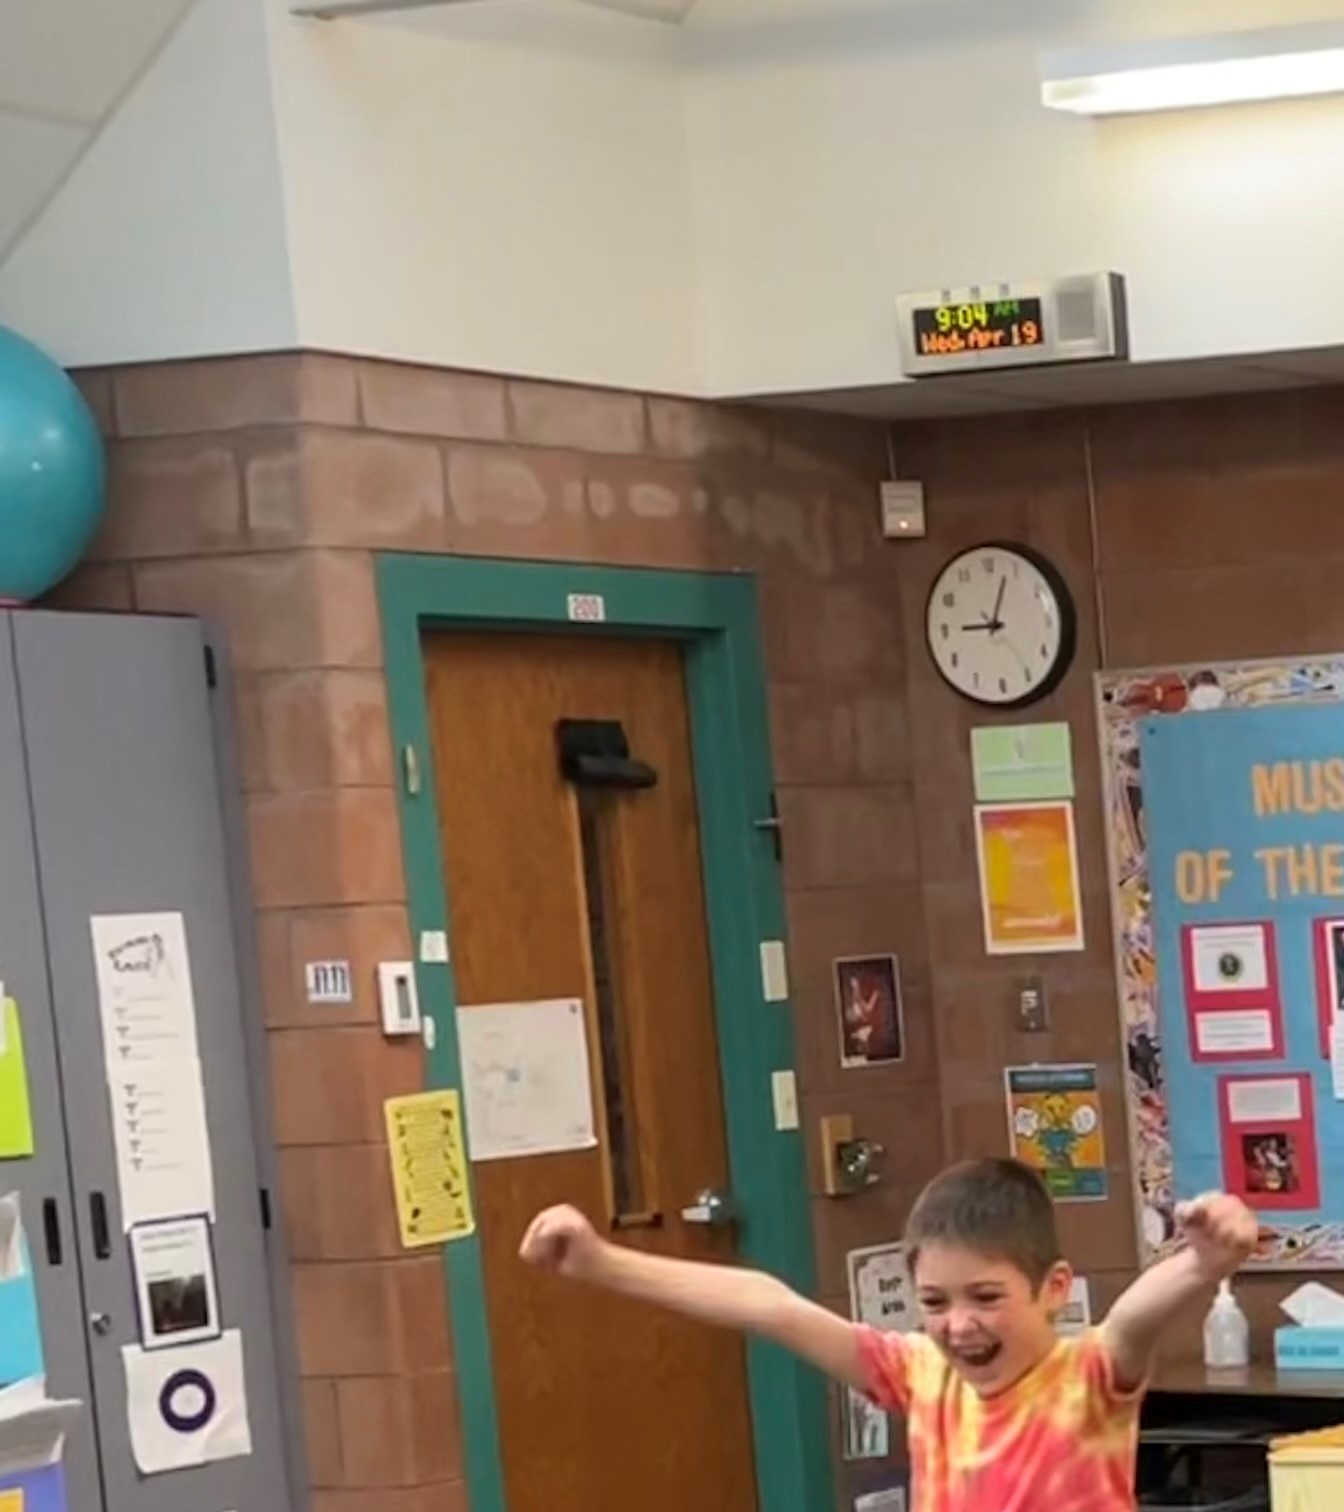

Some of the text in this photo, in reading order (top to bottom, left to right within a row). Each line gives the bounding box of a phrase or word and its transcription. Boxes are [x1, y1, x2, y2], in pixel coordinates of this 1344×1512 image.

[935, 303, 987, 331] 9:04
[1011, 320, 1038, 345] 19
[1176, 850, 1232, 904] OF
